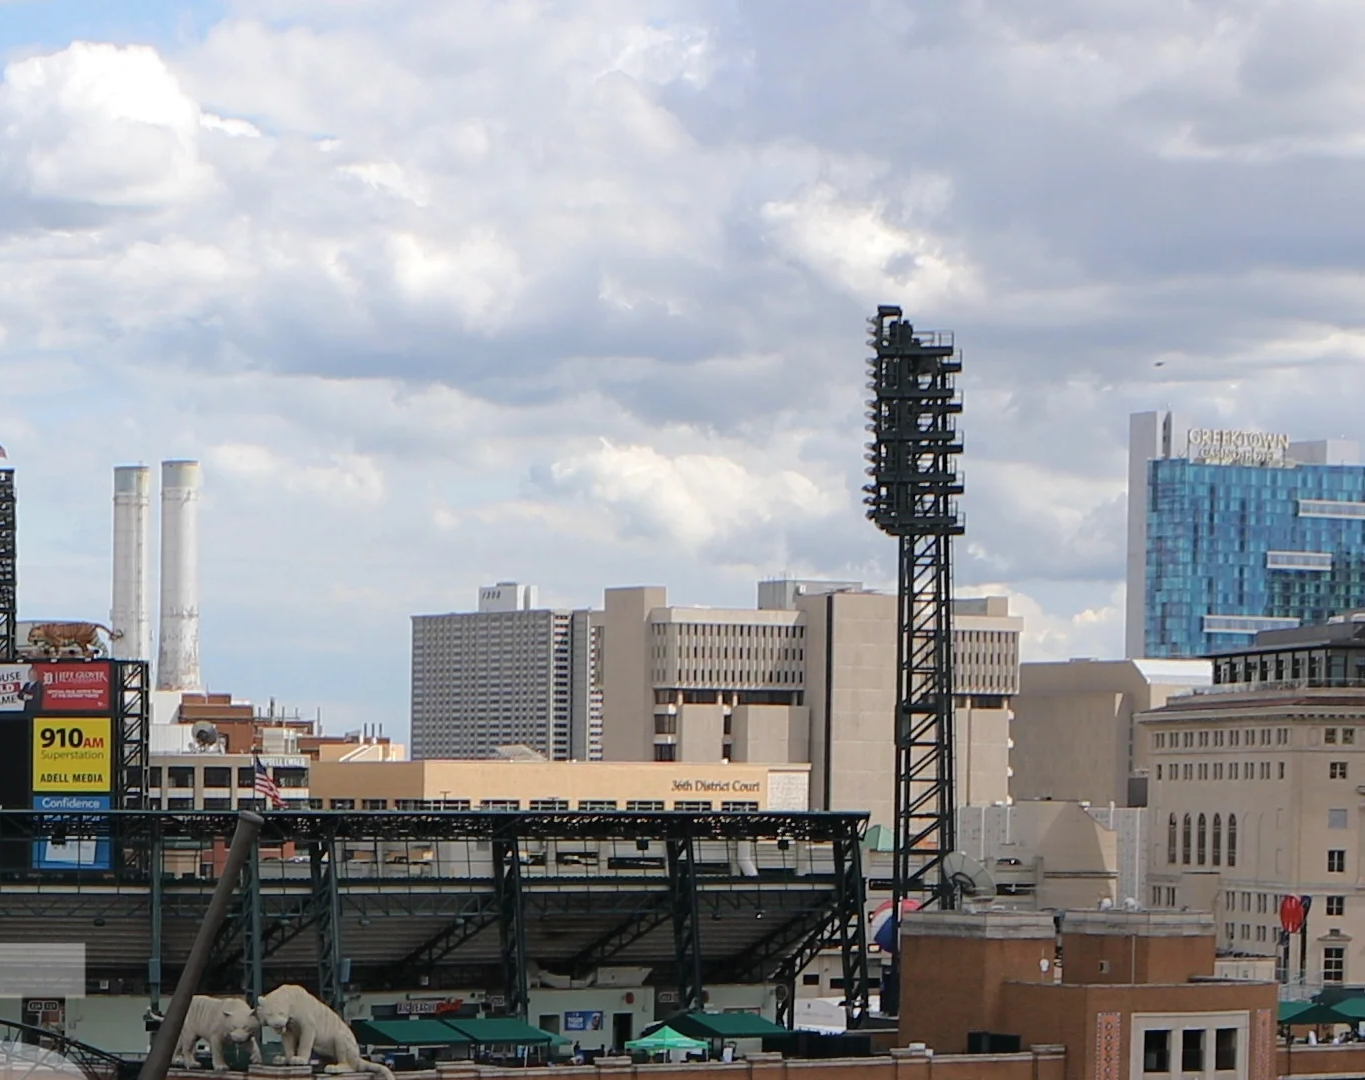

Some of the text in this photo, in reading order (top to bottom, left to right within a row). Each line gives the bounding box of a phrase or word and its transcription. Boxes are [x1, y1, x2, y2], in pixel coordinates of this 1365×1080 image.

[1188, 428, 1289, 449] GREEKTOWN
[41, 750, 104, 760] Superstation
[40, 774, 103, 782] ADELL MEDIA
[671, 780, 760, 791] 36th District Court
[42, 797, 100, 808] Confidence
